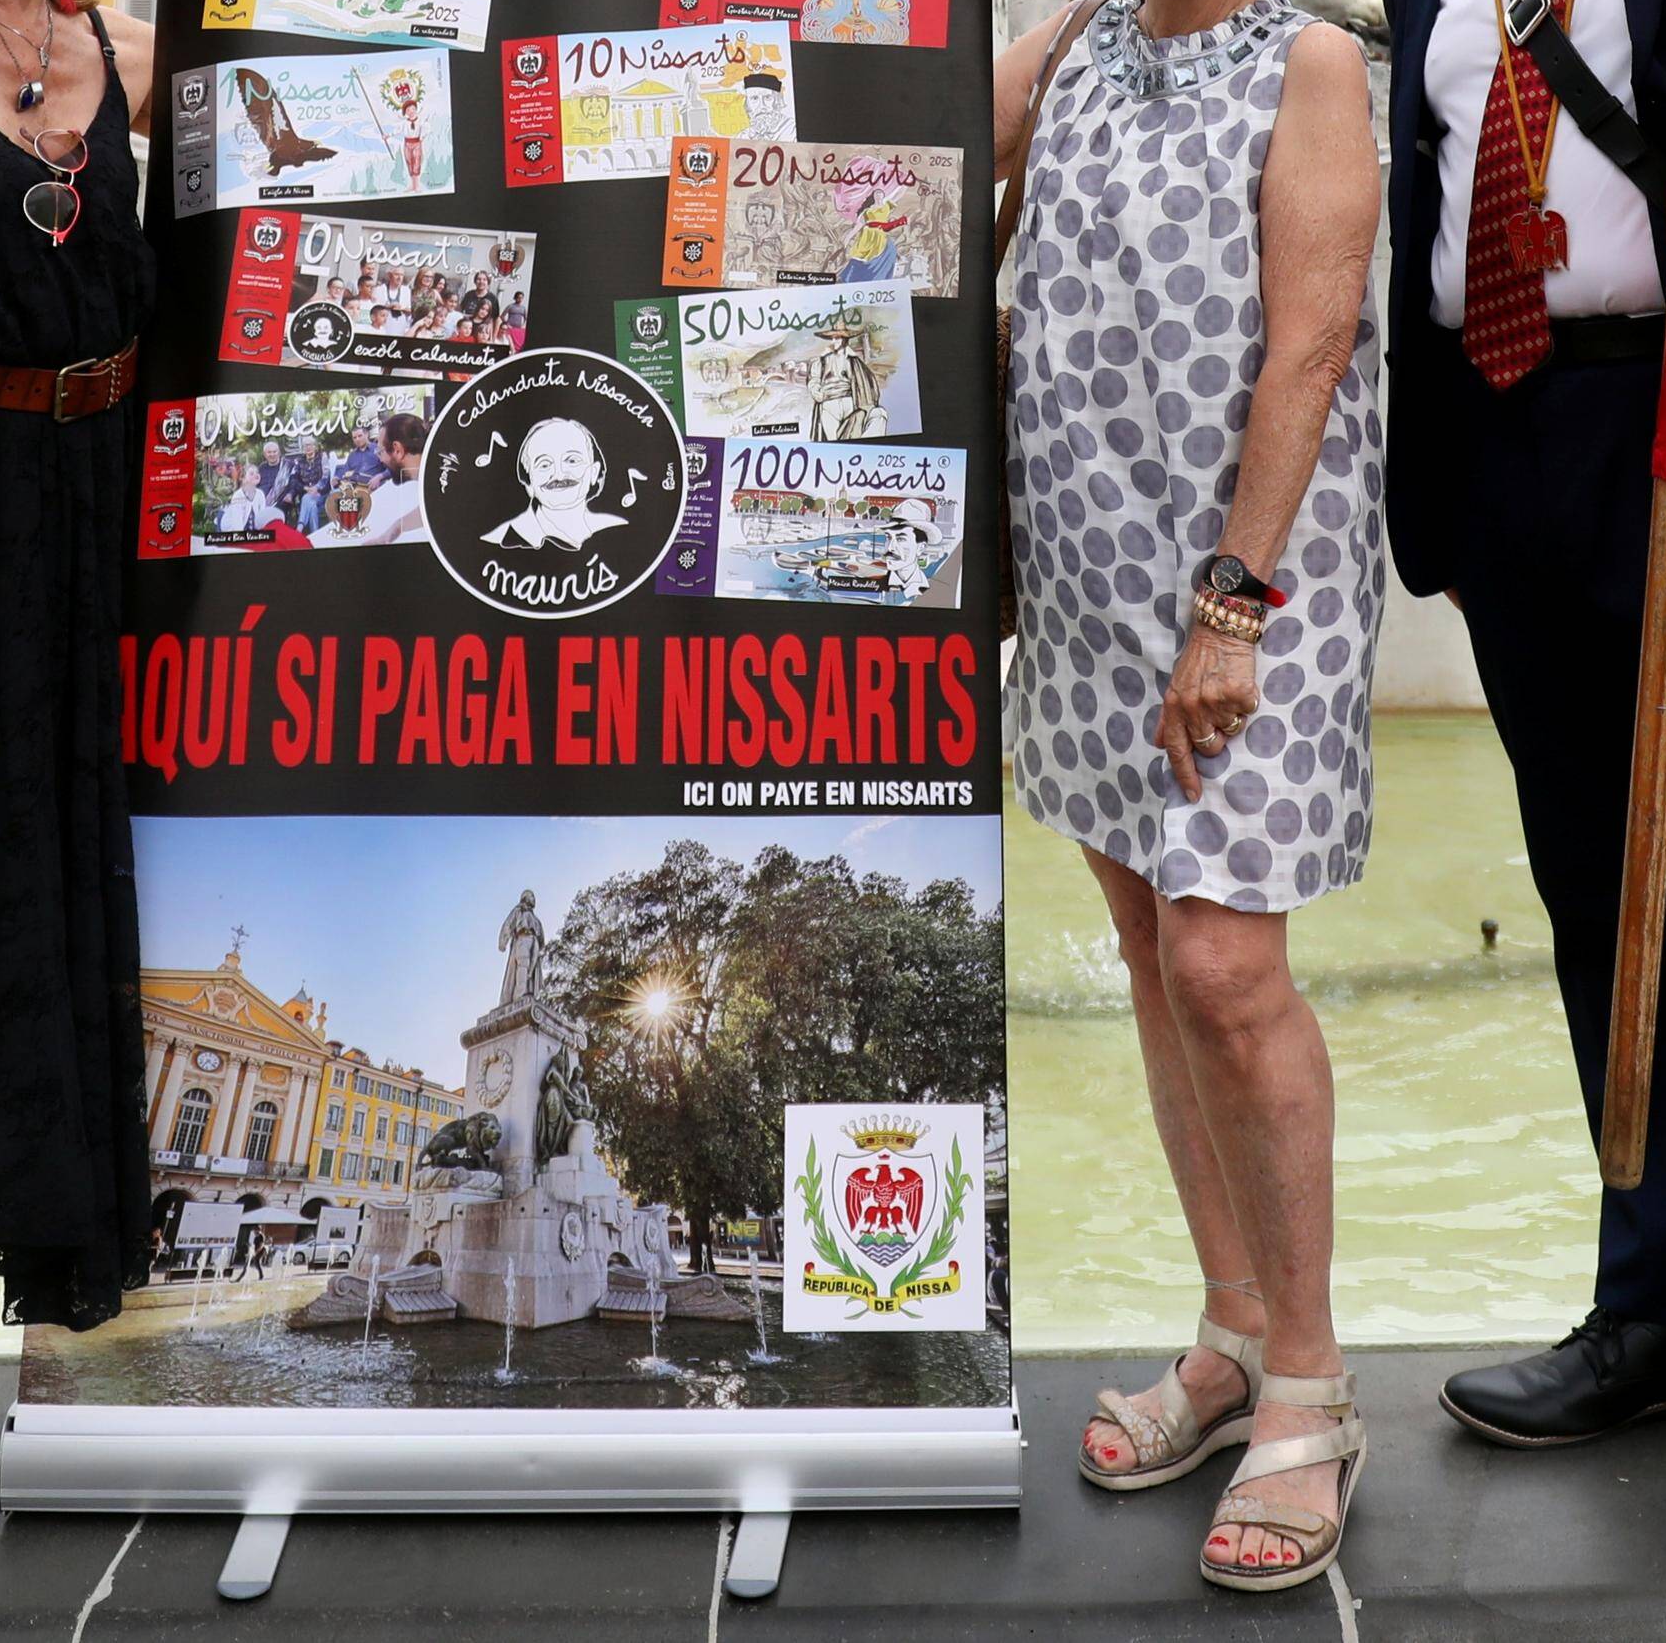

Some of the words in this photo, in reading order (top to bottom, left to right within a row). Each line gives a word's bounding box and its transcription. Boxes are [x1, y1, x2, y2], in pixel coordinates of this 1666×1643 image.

[426, 7, 460, 22] 2025
[565, 37, 613, 84] 10
[620, 33, 745, 74] Nissarts
[701, 67, 725, 78] 2025
[219, 67, 236, 108] 1
[246, 71, 360, 107] Nissart
[297, 106, 332, 120] 2025
[733, 145, 784, 188] 20
[789, 153, 918, 187] Nissarts
[929, 156, 953, 168] 2025
[304, 222, 332, 264] 0
[334, 231, 450, 270] Nissart
[868, 290, 895, 304] 2025
[684, 298, 731, 346] 50
[738, 294, 862, 335] Nissarts
[378, 394, 414, 412] 2025
[457, 357, 570, 427] Calandreta
[576, 369, 653, 428] Nissarda
[200, 406, 221, 447] 0
[227, 401, 349, 442] Nissart
[731, 445, 808, 491] 100
[815, 455, 945, 491] Nissarts
[878, 455, 906, 468] 2025
[272, 633, 337, 768] SI
[359, 634, 532, 767] PAGA
[556, 634, 638, 766] EN
[662, 632, 976, 769] NISSARTS
[683, 782, 716, 806] ICI
[721, 782, 755, 806] ON
[760, 782, 820, 806] PAYE
[826, 782, 855, 806] EN
[862, 781, 973, 806] NISSARTS
[803, 1277, 869, 1297] REPÚBLICA
[874, 1300, 894, 1312] DE
[906, 1281, 952, 1297] NISSA
